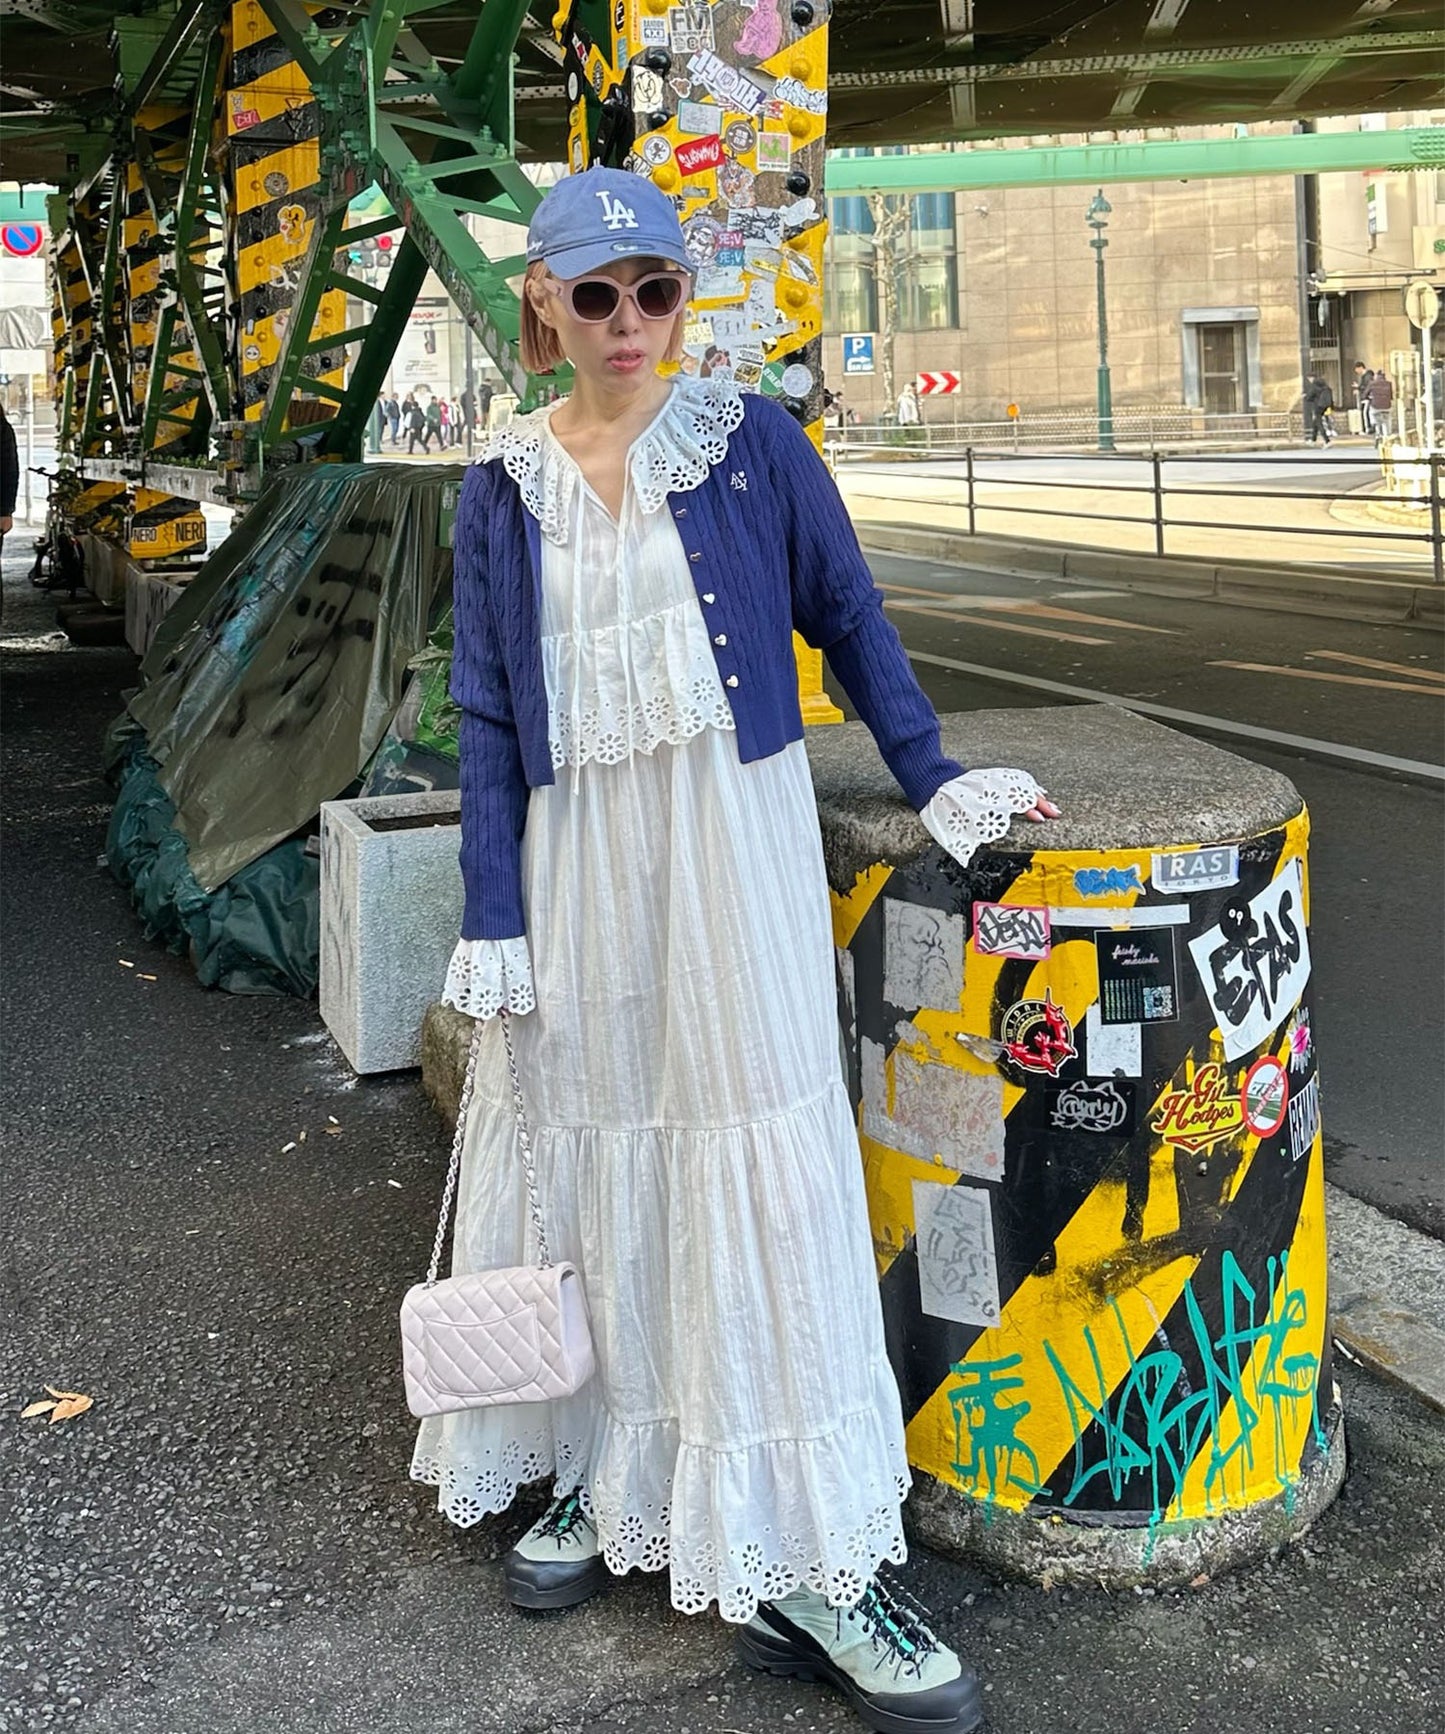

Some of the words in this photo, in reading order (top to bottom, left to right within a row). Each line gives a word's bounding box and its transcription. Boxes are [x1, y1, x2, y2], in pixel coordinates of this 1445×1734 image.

[595, 191, 639, 230] LA
[852, 338, 865, 354] P
[1170, 852, 1224, 877] RAS
[1154, 1094, 1234, 1130] Hodges
